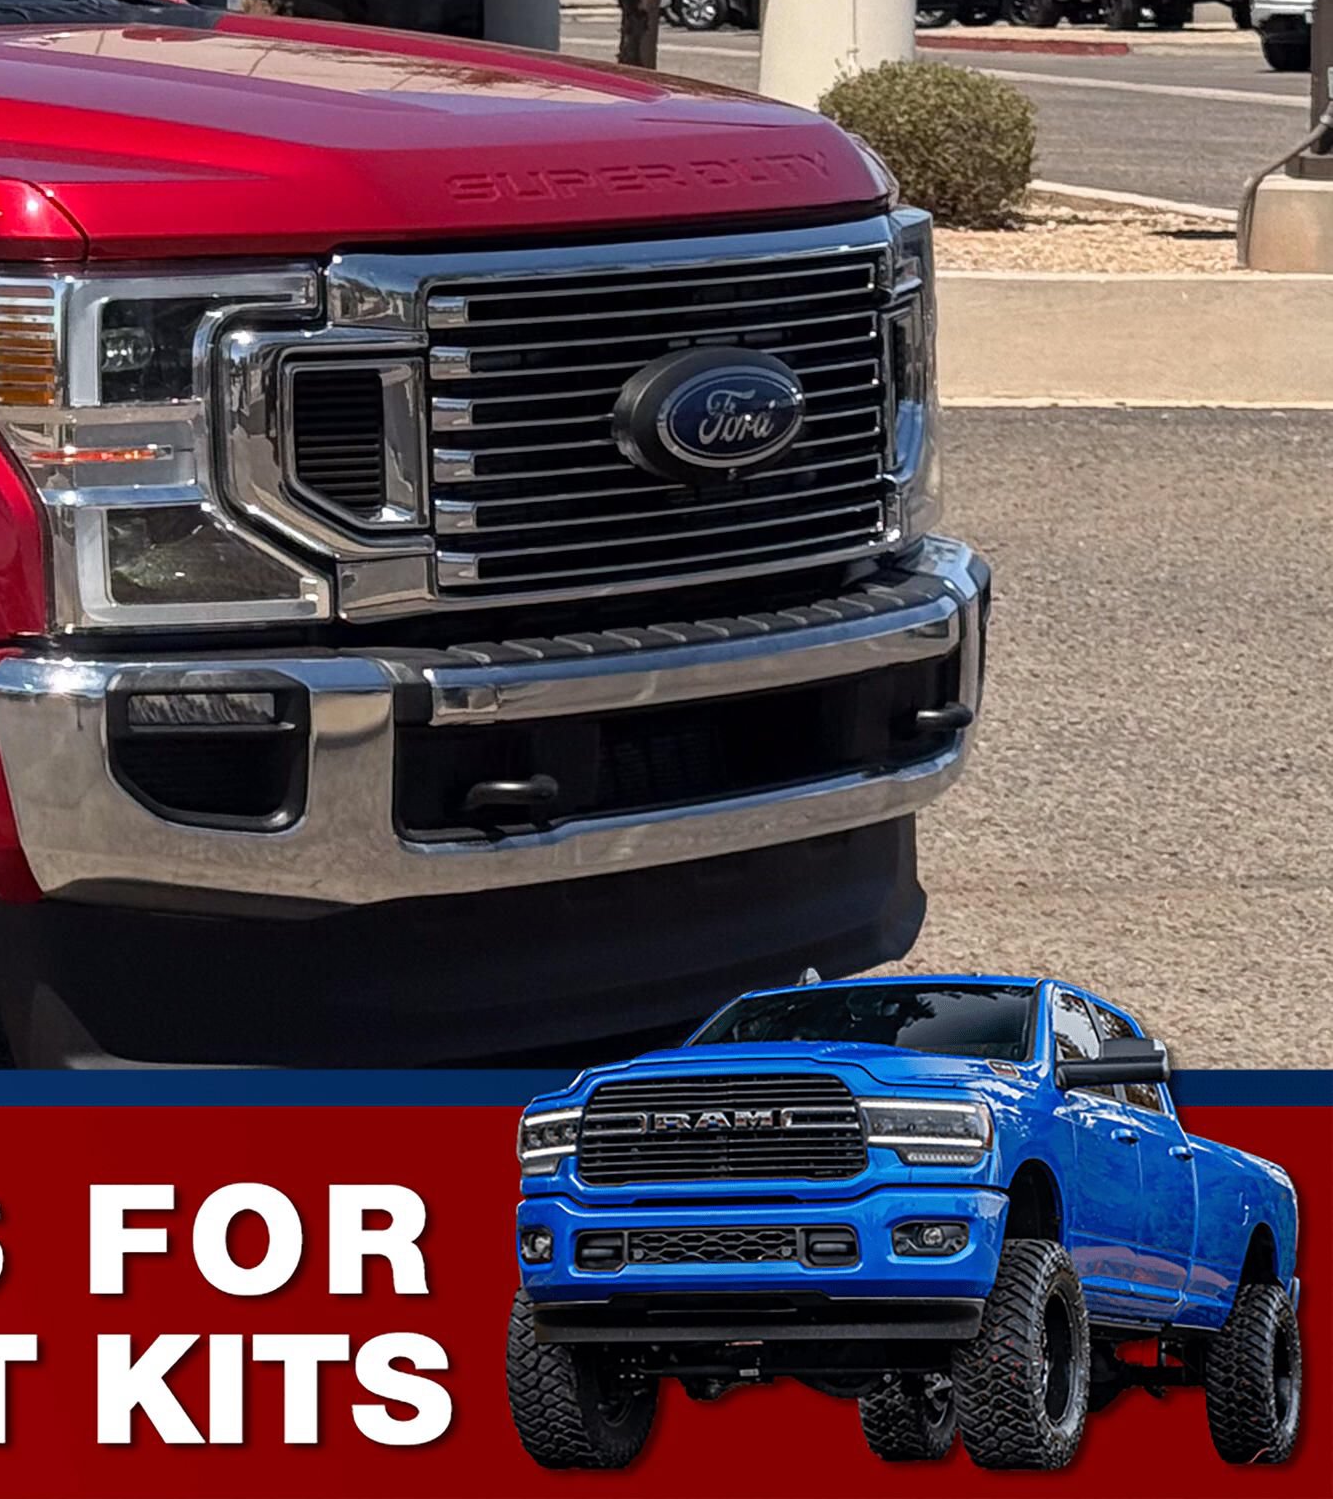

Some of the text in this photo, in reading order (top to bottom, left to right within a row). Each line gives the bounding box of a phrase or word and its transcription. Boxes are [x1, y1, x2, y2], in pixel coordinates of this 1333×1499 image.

[444, 151, 830, 203] SUPER DUTY
[698, 388, 777, 446] Ford
